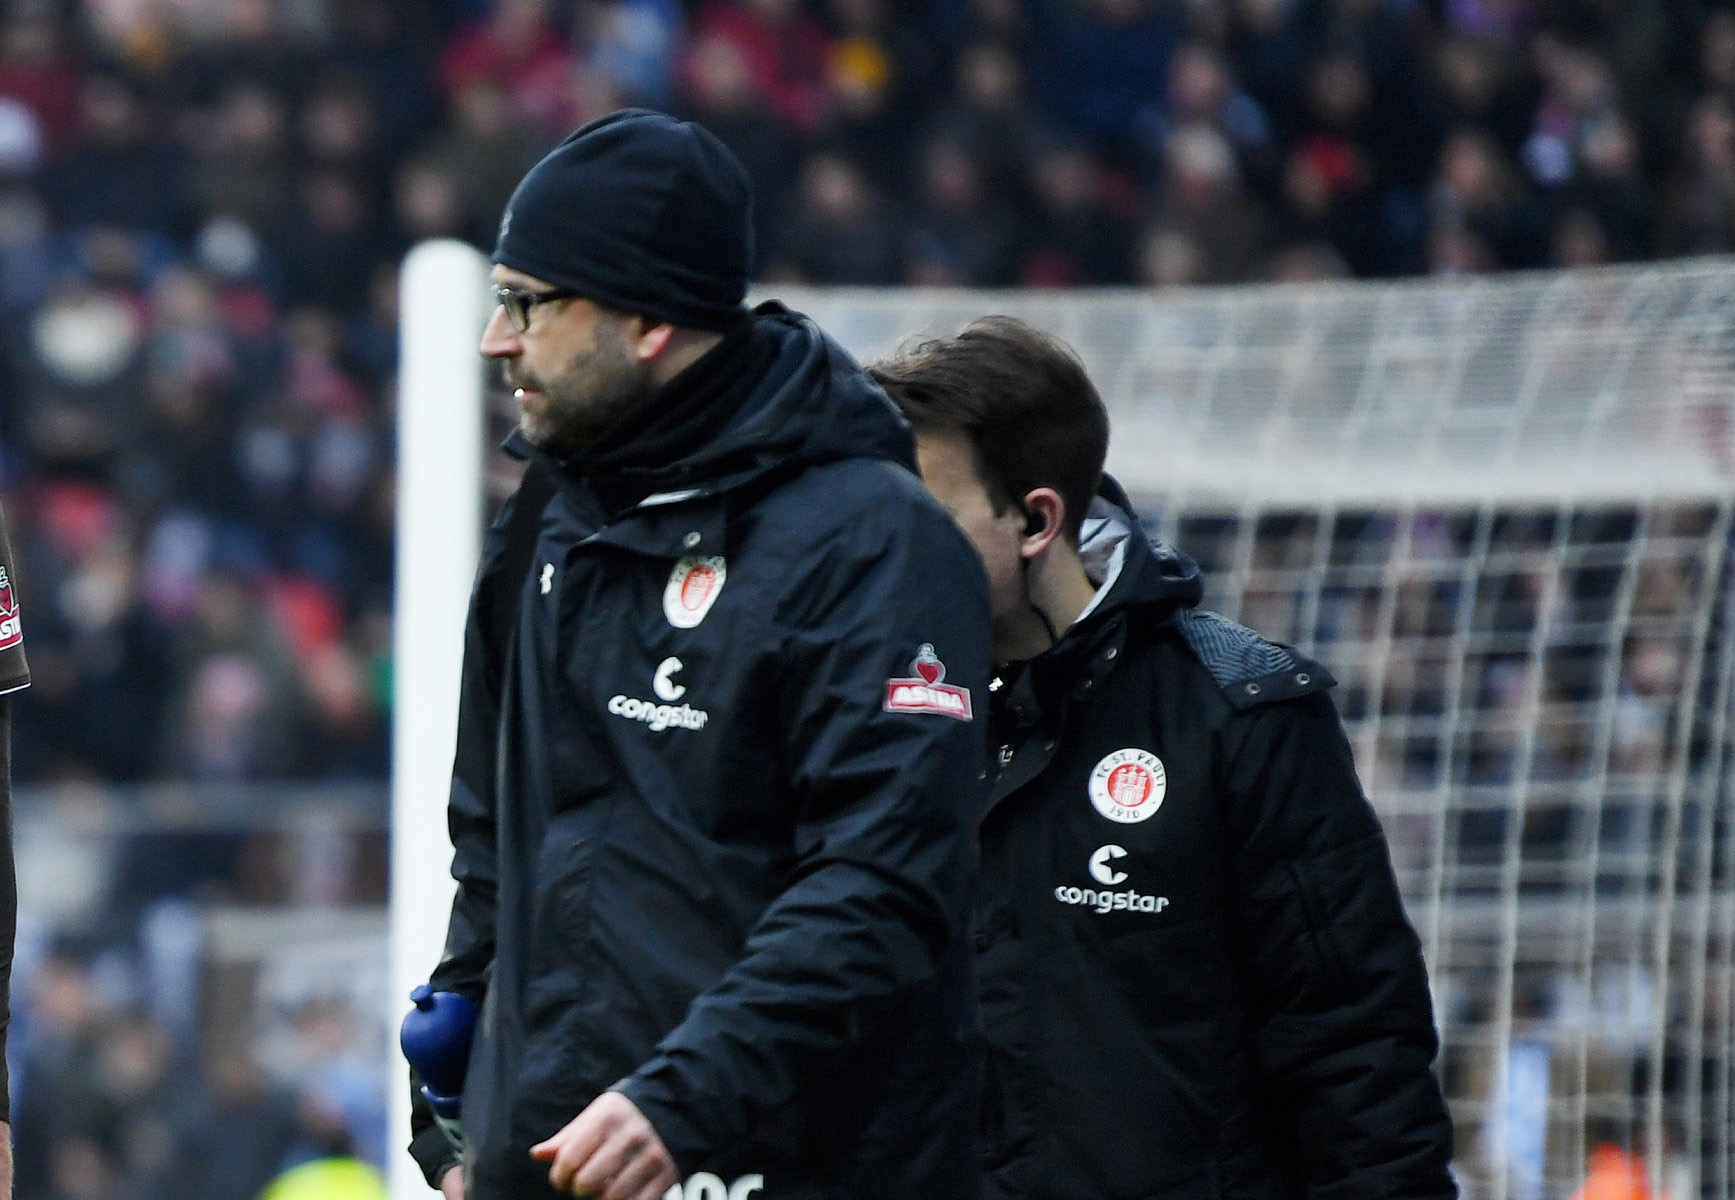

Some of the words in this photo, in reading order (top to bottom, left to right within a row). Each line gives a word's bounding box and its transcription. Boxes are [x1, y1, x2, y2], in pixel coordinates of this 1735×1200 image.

[608, 695, 708, 731] congstar
[1097, 766, 1111, 779] FC
[1137, 752, 1164, 787] PAULI
[1109, 806, 1140, 819] 1910
[1054, 886, 1169, 914] congstar
